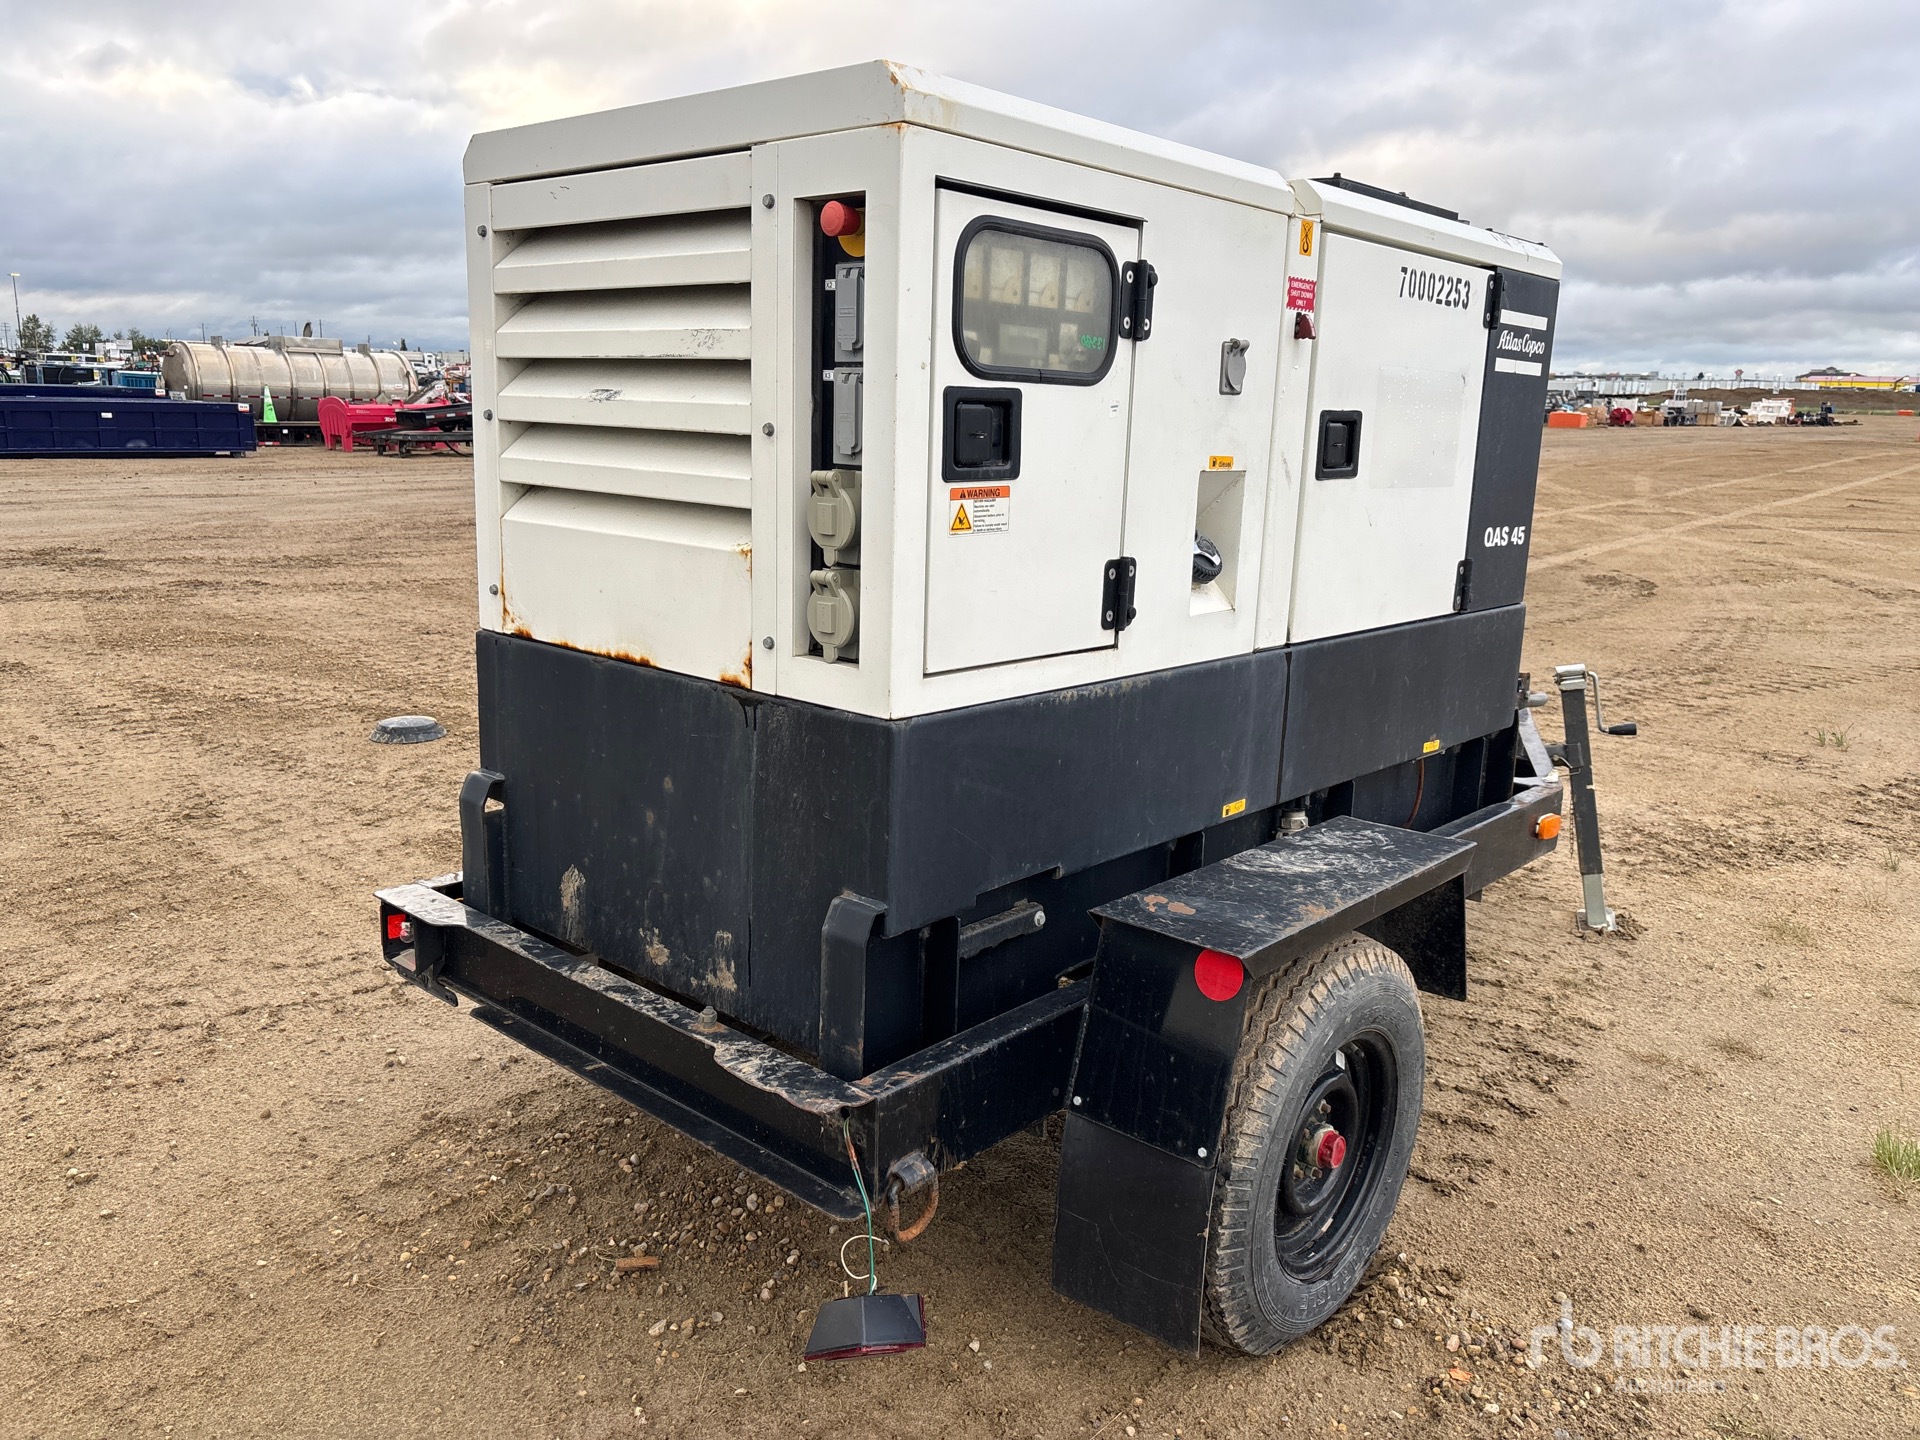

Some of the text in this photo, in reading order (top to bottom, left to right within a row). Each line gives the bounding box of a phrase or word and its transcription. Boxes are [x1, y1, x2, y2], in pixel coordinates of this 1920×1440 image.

[1290, 280, 1314, 291] EMERGENCY
[1399, 266, 1471, 310] 70002253
[1496, 329, 1546, 358] Atlas Copco
[966, 488, 1001, 499] WARNING
[1483, 525, 1526, 548] QAS 45
